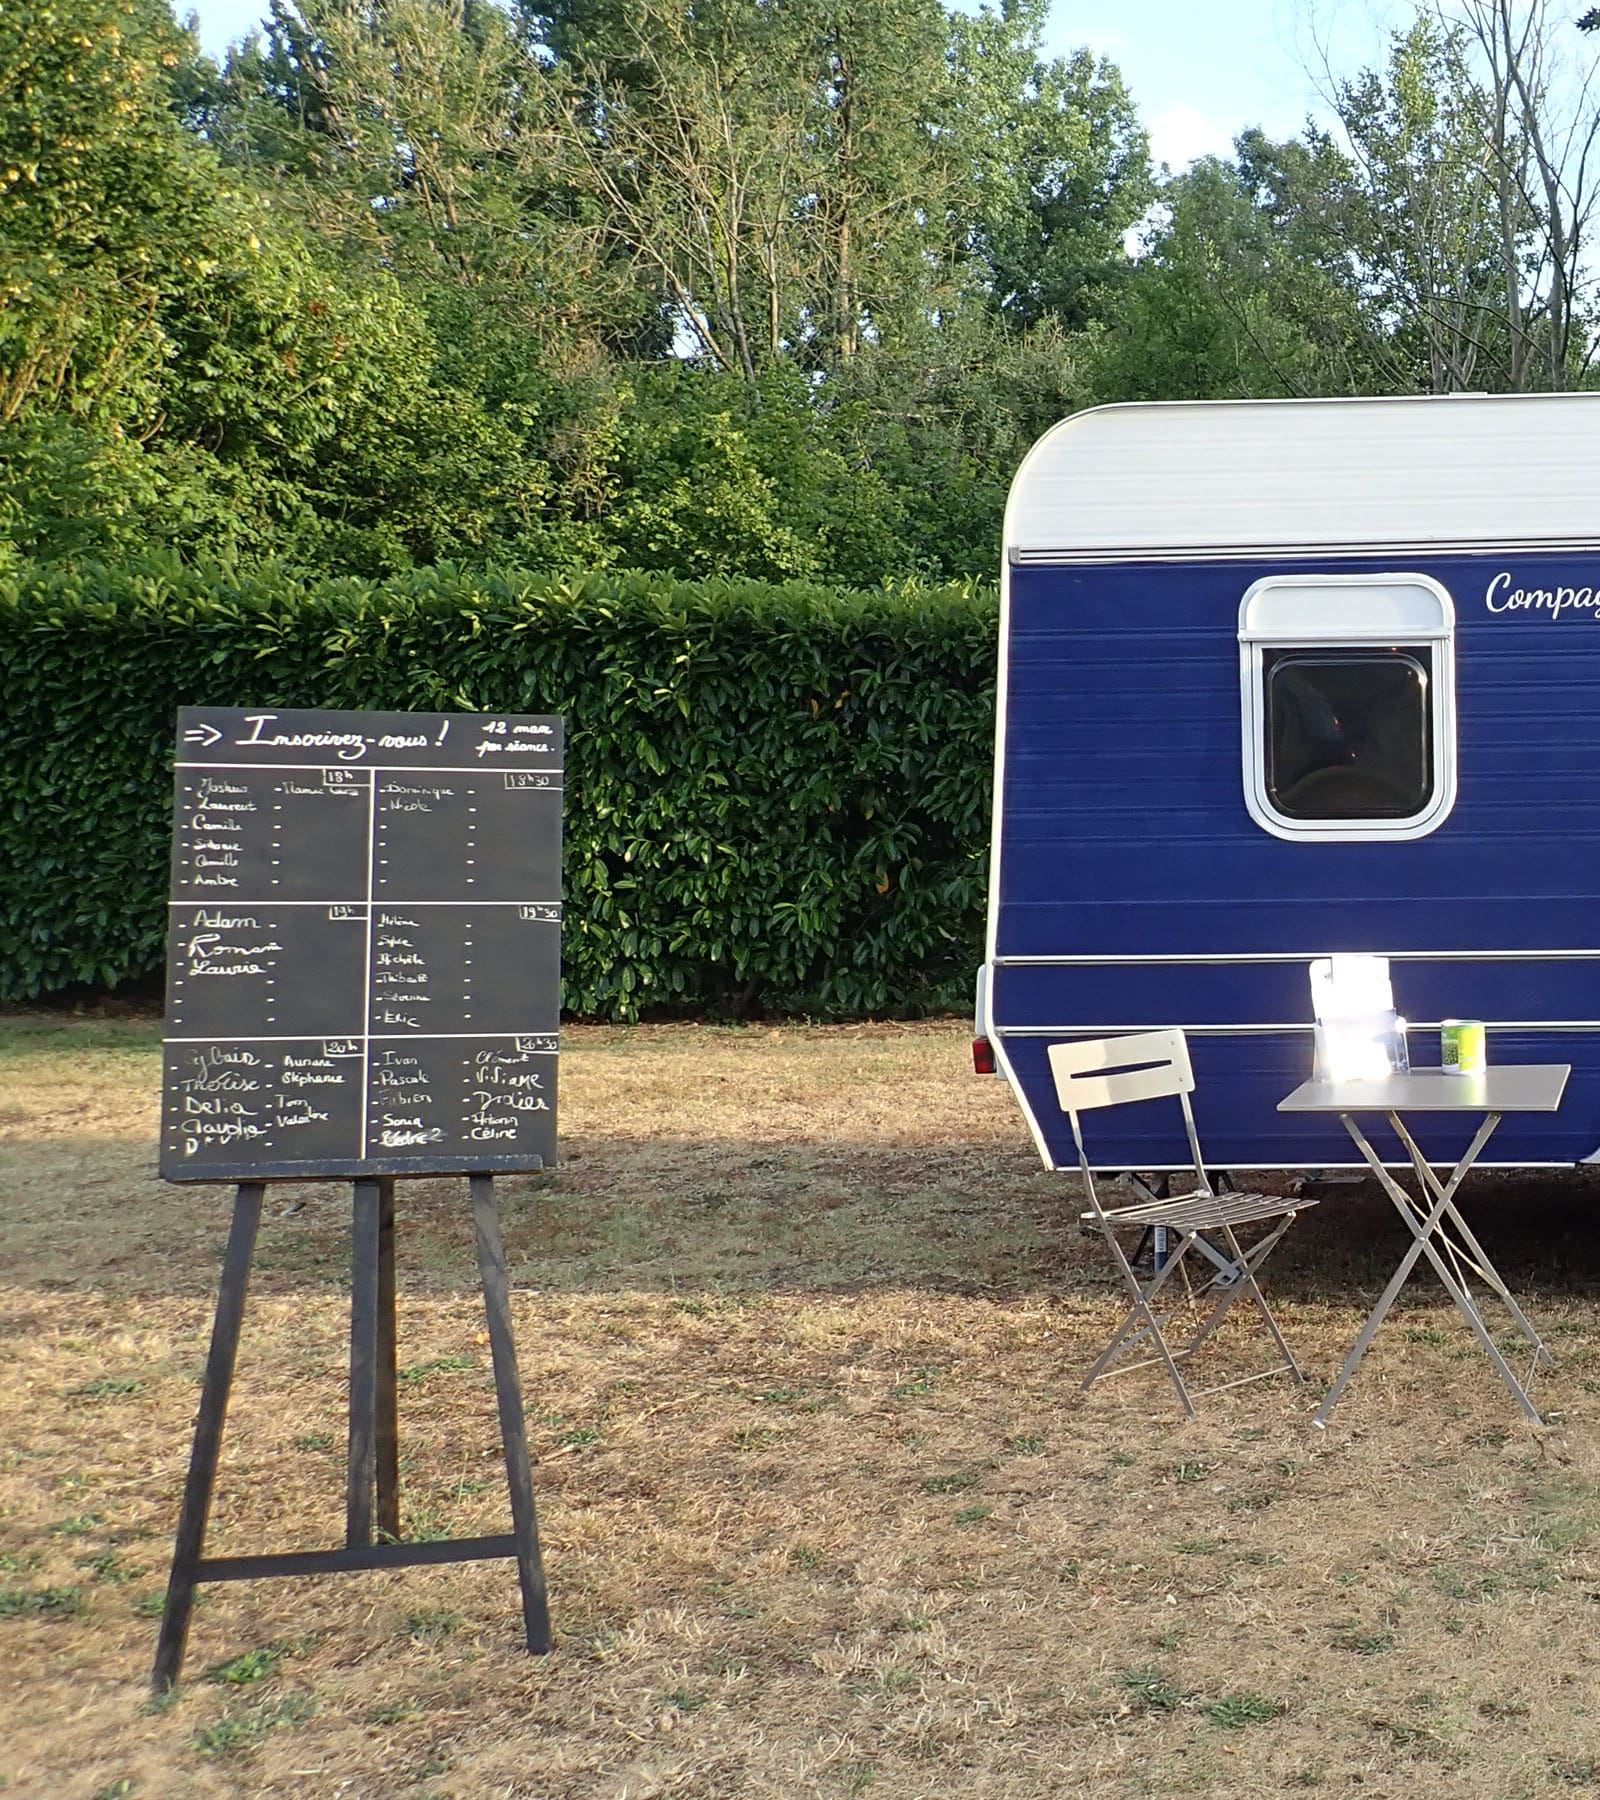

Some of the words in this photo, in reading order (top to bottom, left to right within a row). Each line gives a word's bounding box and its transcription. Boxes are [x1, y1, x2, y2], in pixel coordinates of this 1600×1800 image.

[481, 720, 507, 734] 12
[512, 724, 554, 735] max
[475, 740, 502, 759] par
[328, 770, 354, 783] 18h
[194, 873, 239, 887] Ambre
[193, 909, 262, 929] Adam
[189, 958, 267, 976] Laurie
[327, 1039, 359, 1053] 20h
[382, 1050, 419, 1066] Ivan
[275, 1094, 308, 1109] Tom
[383, 1113, 424, 1128] Sonia
